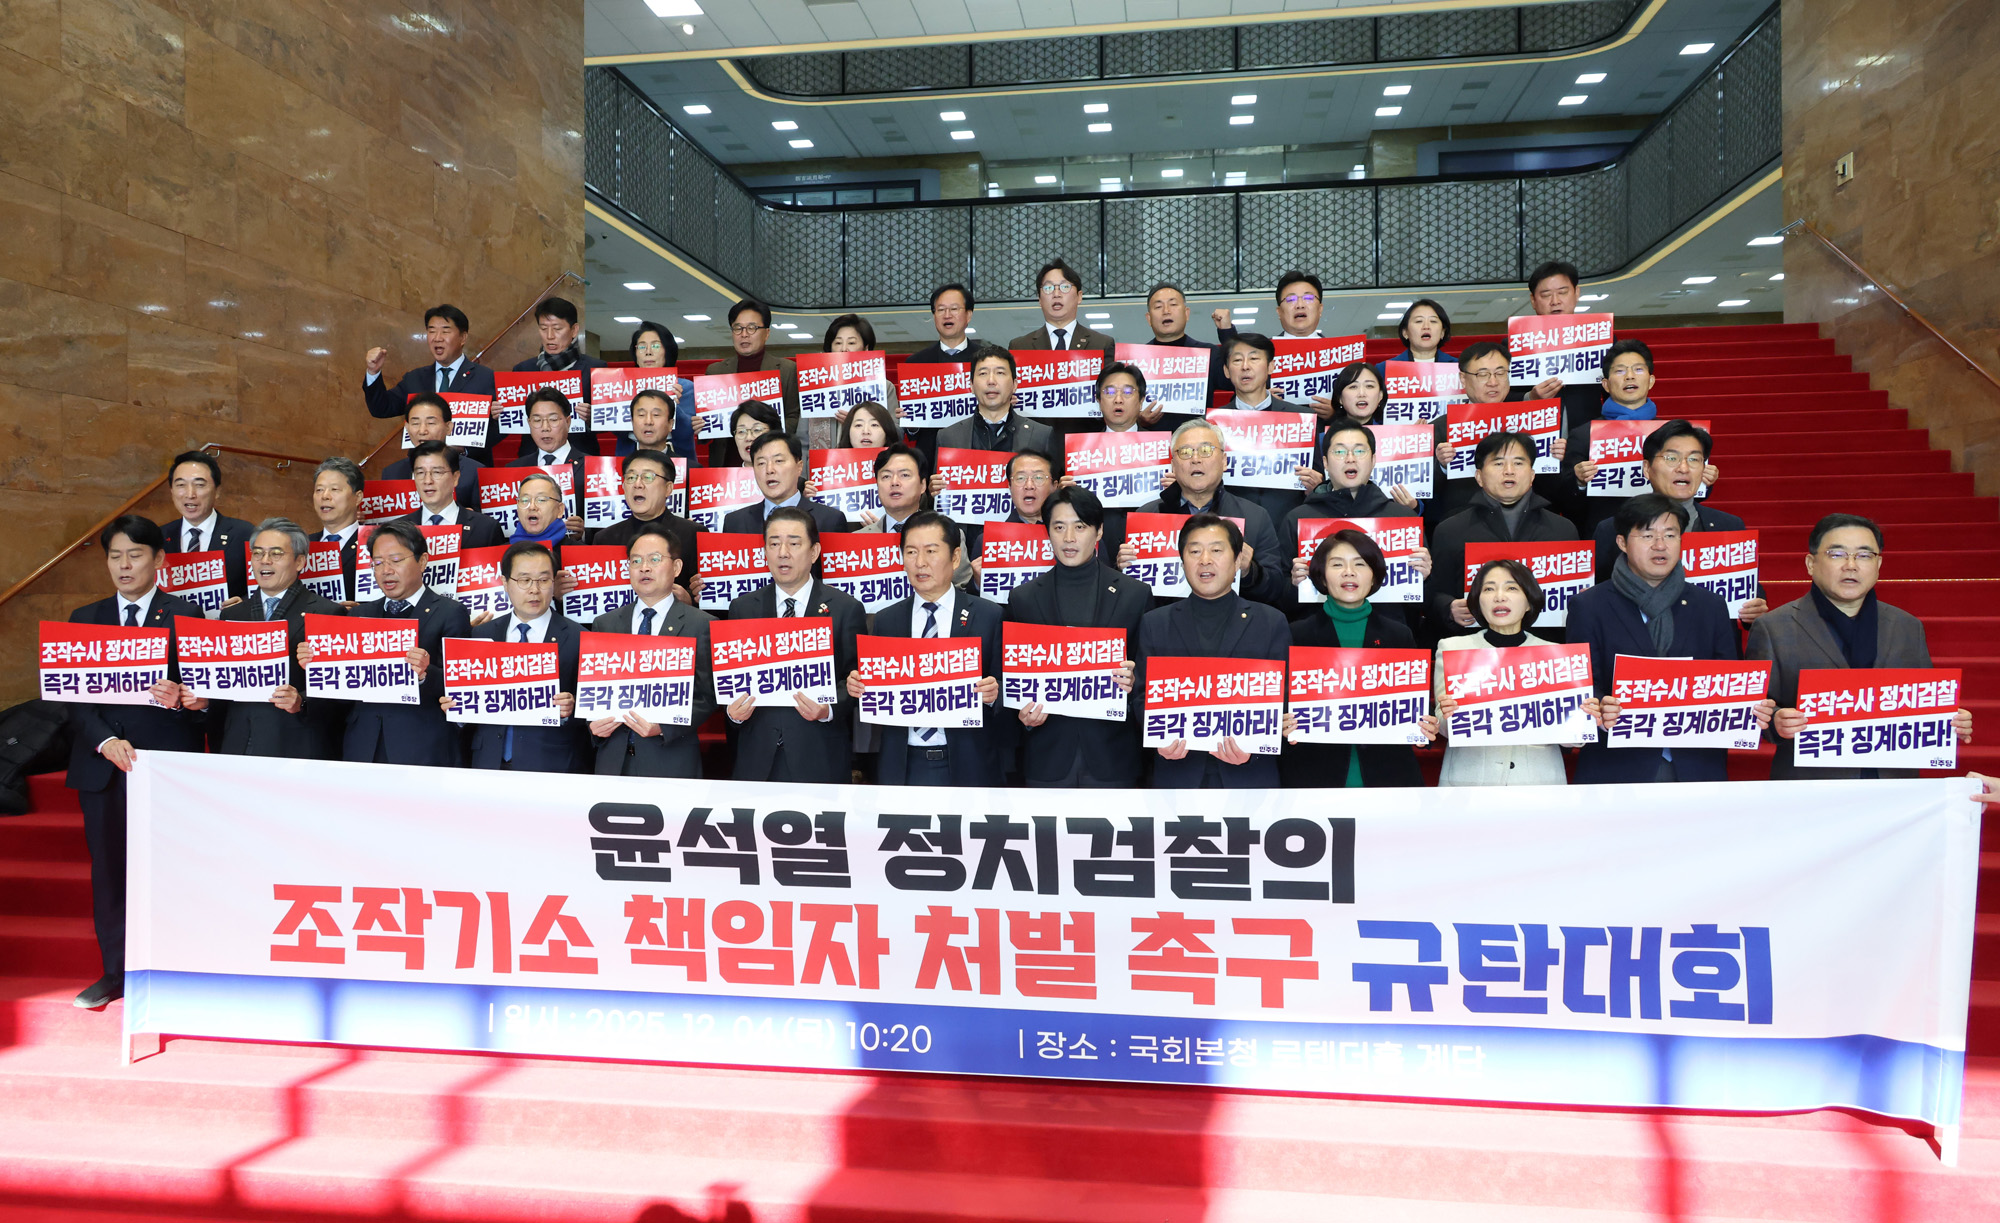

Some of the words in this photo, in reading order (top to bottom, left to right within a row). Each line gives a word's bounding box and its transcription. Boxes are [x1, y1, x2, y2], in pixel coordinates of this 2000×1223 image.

[1510, 330, 1559, 351] 조작수사
[1562, 320, 1611, 346] 정치검찰
[1057, 357, 1102, 378] 정치검찰
[1163, 356, 1208, 375] 정치검찰
[1273, 353, 1316, 373] 조작수사
[1319, 341, 1365, 367] 정치검찰
[1511, 358, 1540, 379] 즉각
[799, 366, 839, 387] 조작수사
[842, 358, 884, 380] 정치검찰
[1386, 375, 1432, 394] 조작수사
[592, 381, 634, 400] 조작수사
[636, 374, 677, 394] 정치검찰
[696, 388, 738, 408] 조작수사
[740, 377, 780, 398] 정치검찰
[900, 377, 941, 396] 조작수사
[1146, 381, 1204, 403] 징계하라!
[449, 400, 490, 415] 정치검찰
[593, 407, 619, 425] 즉각
[802, 393, 826, 412] 즉각
[901, 402, 927, 420] 즉각
[1386, 402, 1414, 420] 즉각
[500, 410, 523, 428] 즉각
[701, 412, 724, 432] 즉각
[1449, 416, 1502, 442] 조작수사
[1505, 406, 1558, 434] 정치검찰
[1262, 423, 1314, 444] 정치검찰
[1380, 431, 1432, 456] 정치검찰
[1066, 446, 1116, 472] 조작수사
[1119, 439, 1170, 464] 정치검찰
[1592, 438, 1644, 458] 조작수사
[811, 462, 858, 486] 조작수사
[938, 465, 987, 484] 조작수사
[1591, 469, 1625, 489] 즉각
[361, 494, 406, 515] 조작수사
[690, 482, 736, 505] 조작수사
[587, 499, 616, 521] 즉각
[692, 509, 719, 532] 즉각
[700, 550, 749, 572] 조작수사
[823, 551, 873, 573] 조작수사
[876, 546, 904, 569] 정치
[984, 539, 1037, 562] 조작수사
[1531, 549, 1592, 579] 정치검찰
[1700, 540, 1757, 571] 정치검찰
[171, 558, 224, 587] 정치검찰
[984, 572, 1016, 595] 즉각
[701, 580, 732, 601] 즉각
[458, 594, 490, 615] 즉각
[566, 594, 598, 616] 즉각
[41, 640, 102, 663] 조작수사
[106, 637, 167, 661] 정치검찰
[178, 635, 227, 657] 조작수사
[230, 630, 287, 656] 정치검찰
[307, 633, 359, 655] 조작수사
[361, 628, 417, 653] 정치검찰
[713, 637, 772, 665] 조작수사
[775, 627, 832, 655] 정치검찰
[1004, 643, 1063, 667] 조작수사
[1066, 638, 1125, 666] 정치검찰
[446, 657, 498, 681] 조작수사
[501, 652, 557, 679] 정치검찰
[580, 652, 636, 675] 조작수사
[639, 647, 694, 672] 정치검찰
[859, 654, 915, 680] 조작수사
[918, 647, 980, 676] 정치검찰
[44, 672, 80, 694] 즉각
[181, 667, 211, 690] 즉각
[216, 662, 286, 689] 징계하라!
[308, 666, 340, 690] 즉각
[345, 662, 415, 689] 징계하라!
[717, 673, 752, 698] 즉각
[757, 661, 832, 695] 징계하라!
[1147, 675, 1212, 704] 조작수사
[1216, 671, 1283, 698] 정치검찰
[1290, 667, 1357, 695] 조작수사
[1361, 660, 1428, 690] 정치검찰
[1447, 666, 1515, 700] 조작수사
[1519, 654, 1589, 688] 정치검찰
[1614, 677, 1688, 703] 조작수사
[1692, 670, 1766, 699] 정치검찰
[448, 691, 479, 715] 즉각
[484, 685, 557, 713] 징계하라!
[579, 685, 613, 711] 즉각
[618, 682, 690, 710] 징계하라!
[861, 691, 894, 716] 즉각
[899, 683, 979, 715] 징계하라!
[1005, 678, 1039, 703] 즉각
[1799, 691, 1874, 717] 조작수사
[1879, 680, 1957, 711] 정치검찰
[1147, 713, 1187, 739] 즉각
[1193, 709, 1278, 738] 징계하라!
[1292, 706, 1332, 734] 즉각
[1338, 697, 1425, 731] 징계하라!
[1452, 708, 1492, 738] 즉각
[1612, 713, 1657, 739] 즉각
[1799, 730, 1844, 757] 즉각
[1852, 719, 1951, 754] 징계하라!
[588, 802, 851, 888] 윤석열
[877, 813, 1356, 904] 정치검찰의
[269, 884, 598, 975] 조작기소
[624, 894, 890, 990] 책임자
[914, 905, 1097, 1000] 처벌
[1128, 911, 1319, 1009] 촉구
[1352, 919, 1773, 1025] 규탄대회
[504, 1004, 559, 1034] 일시
[845, 1021, 932, 1054] 10:20
[1036, 1031, 1098, 1060] 장소
[1129, 1034, 1258, 1067] 국회본청
[1417, 1043, 1486, 1077] 계단
